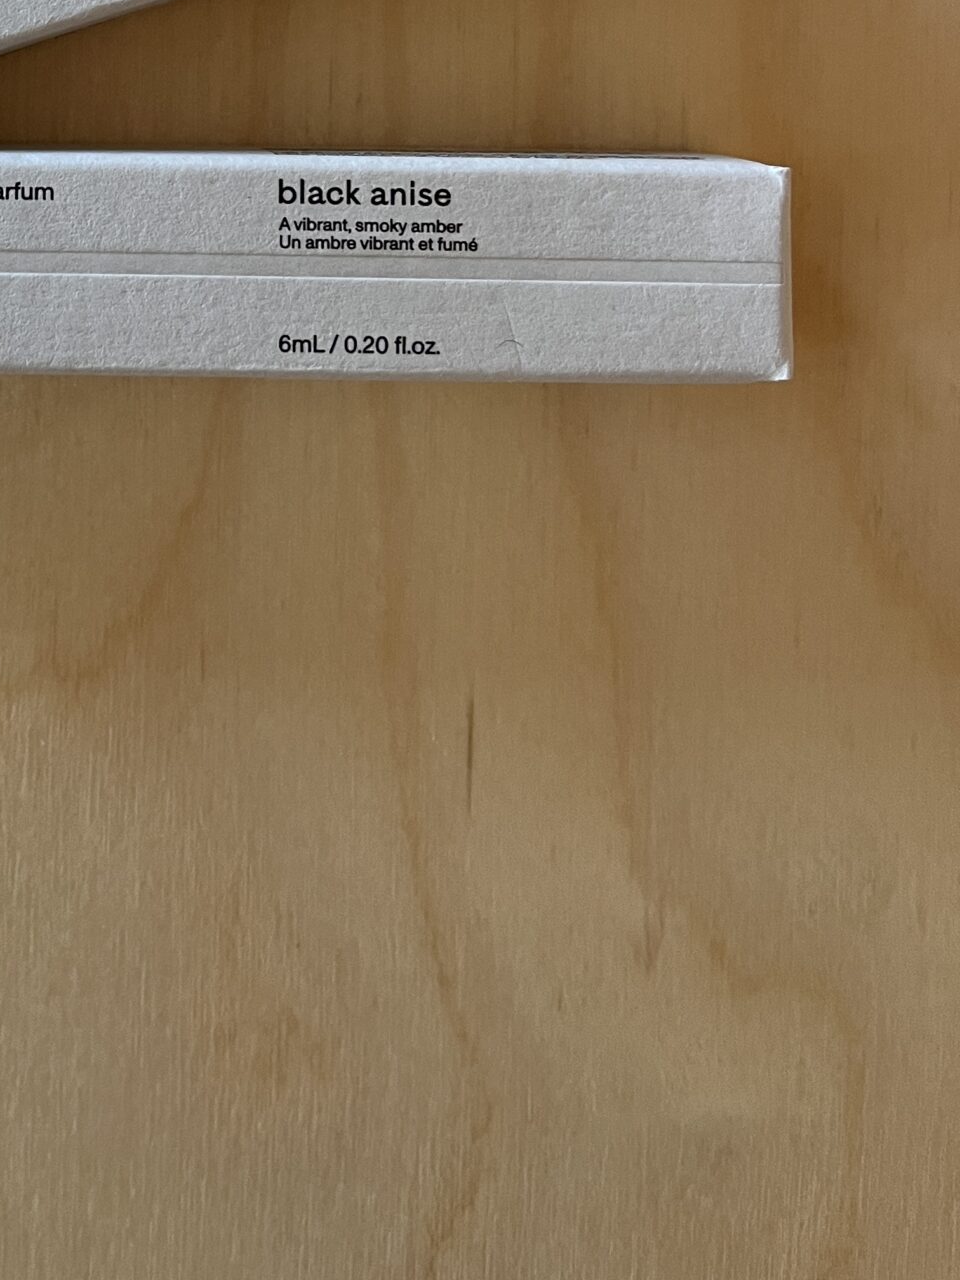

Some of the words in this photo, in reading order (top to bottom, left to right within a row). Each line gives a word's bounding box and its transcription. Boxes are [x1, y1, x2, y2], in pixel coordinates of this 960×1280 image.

[278, 178, 361, 205] black
[370, 180, 452, 207] anise
[278, 217, 291, 232] A
[293, 218, 352, 234] vibrant,
[355, 219, 407, 236] smoky
[411, 220, 463, 234] amber
[279, 235, 301, 249] Un
[305, 236, 357, 250] ambre
[360, 236, 415, 250] vibrant
[418, 239, 434, 251] et
[437, 237, 478, 252] fumé
[278, 335, 325, 354] 6mL
[344, 335, 389, 354] 0.20
[394, 336, 441, 355] fl.oz.
